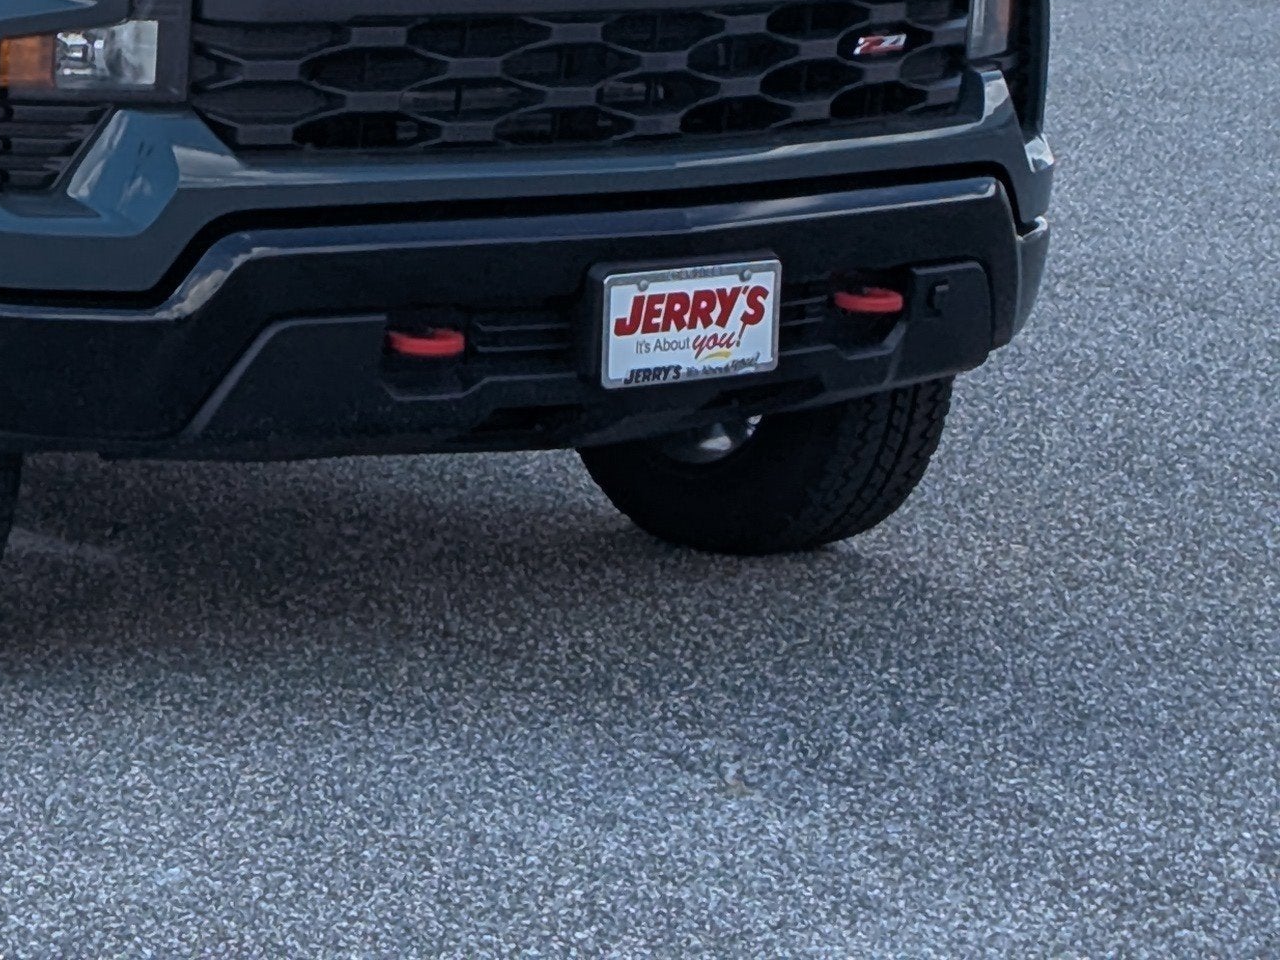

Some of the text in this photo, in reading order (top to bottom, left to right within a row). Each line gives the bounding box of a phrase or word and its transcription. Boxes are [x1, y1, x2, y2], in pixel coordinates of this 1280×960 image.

[614, 285, 769, 337] JERRY'S
[636, 325, 743, 359] It's About you!
[623, 364, 682, 385] JERRY'S
